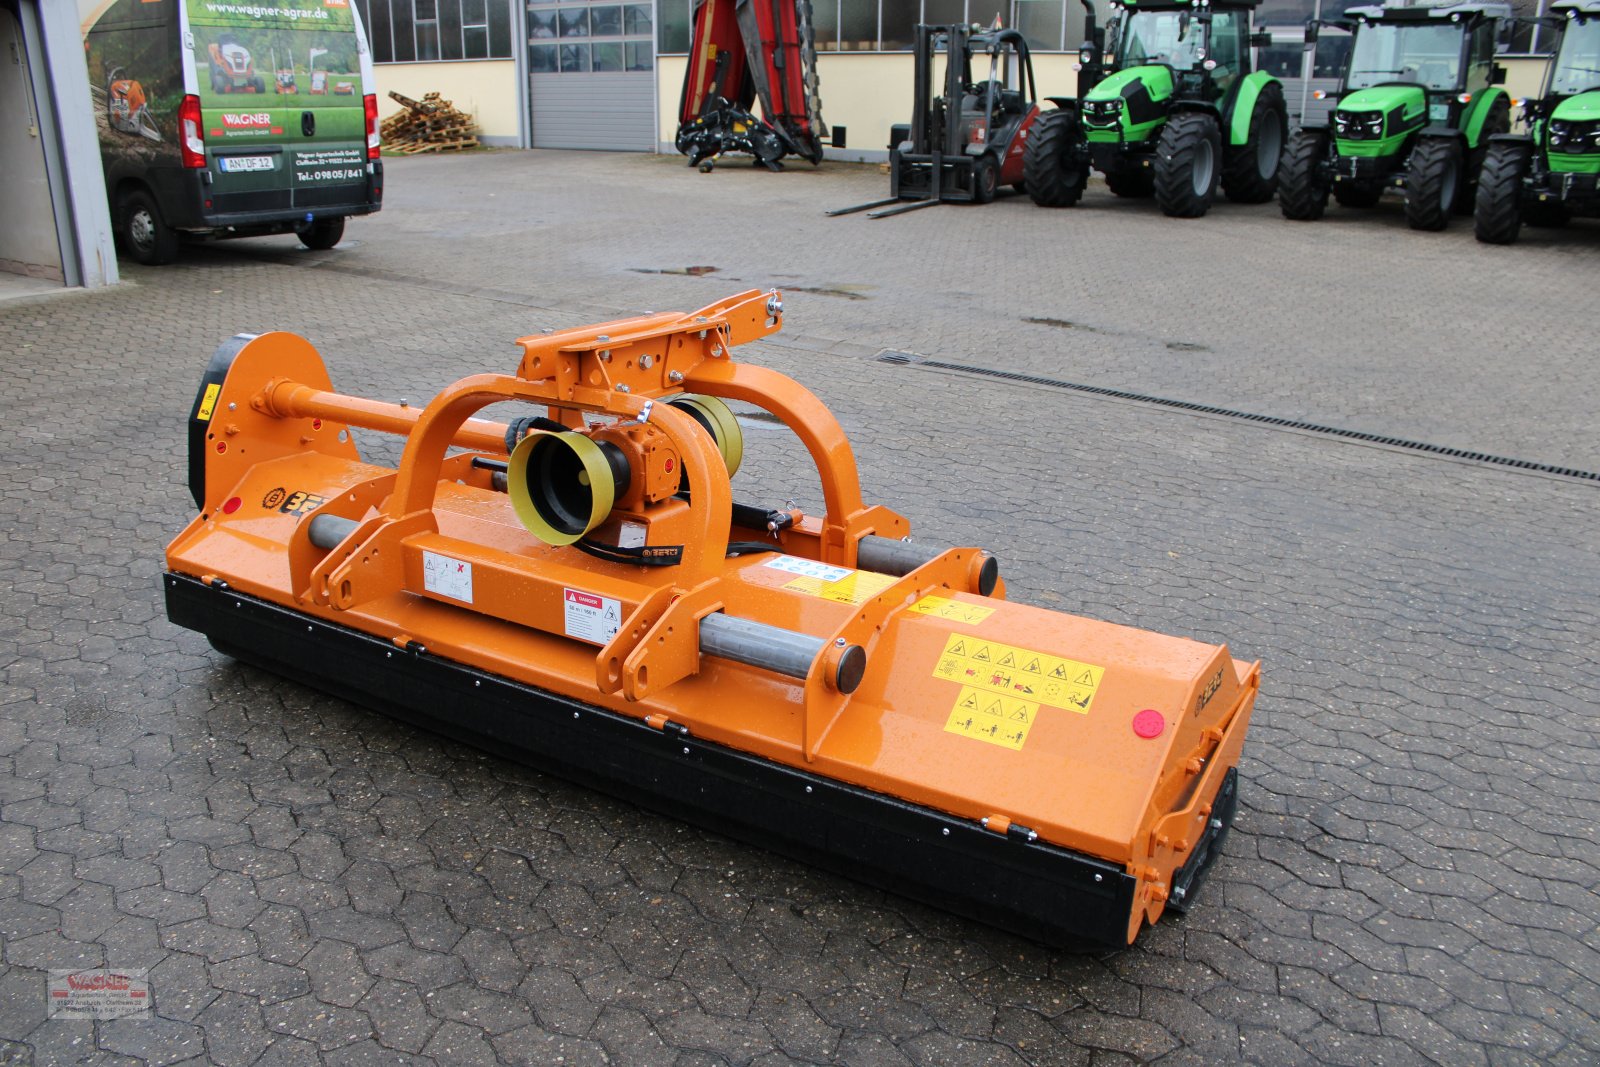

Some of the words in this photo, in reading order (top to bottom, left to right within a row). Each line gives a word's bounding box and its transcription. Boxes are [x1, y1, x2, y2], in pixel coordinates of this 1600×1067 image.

[206, 3, 329, 20] www.wagner-agrar.de
[224, 113, 272, 125] WAGNER
[229, 159, 241, 169] AN
[259, 157, 271, 168] 12
[296, 171, 314, 181] Tel.:
